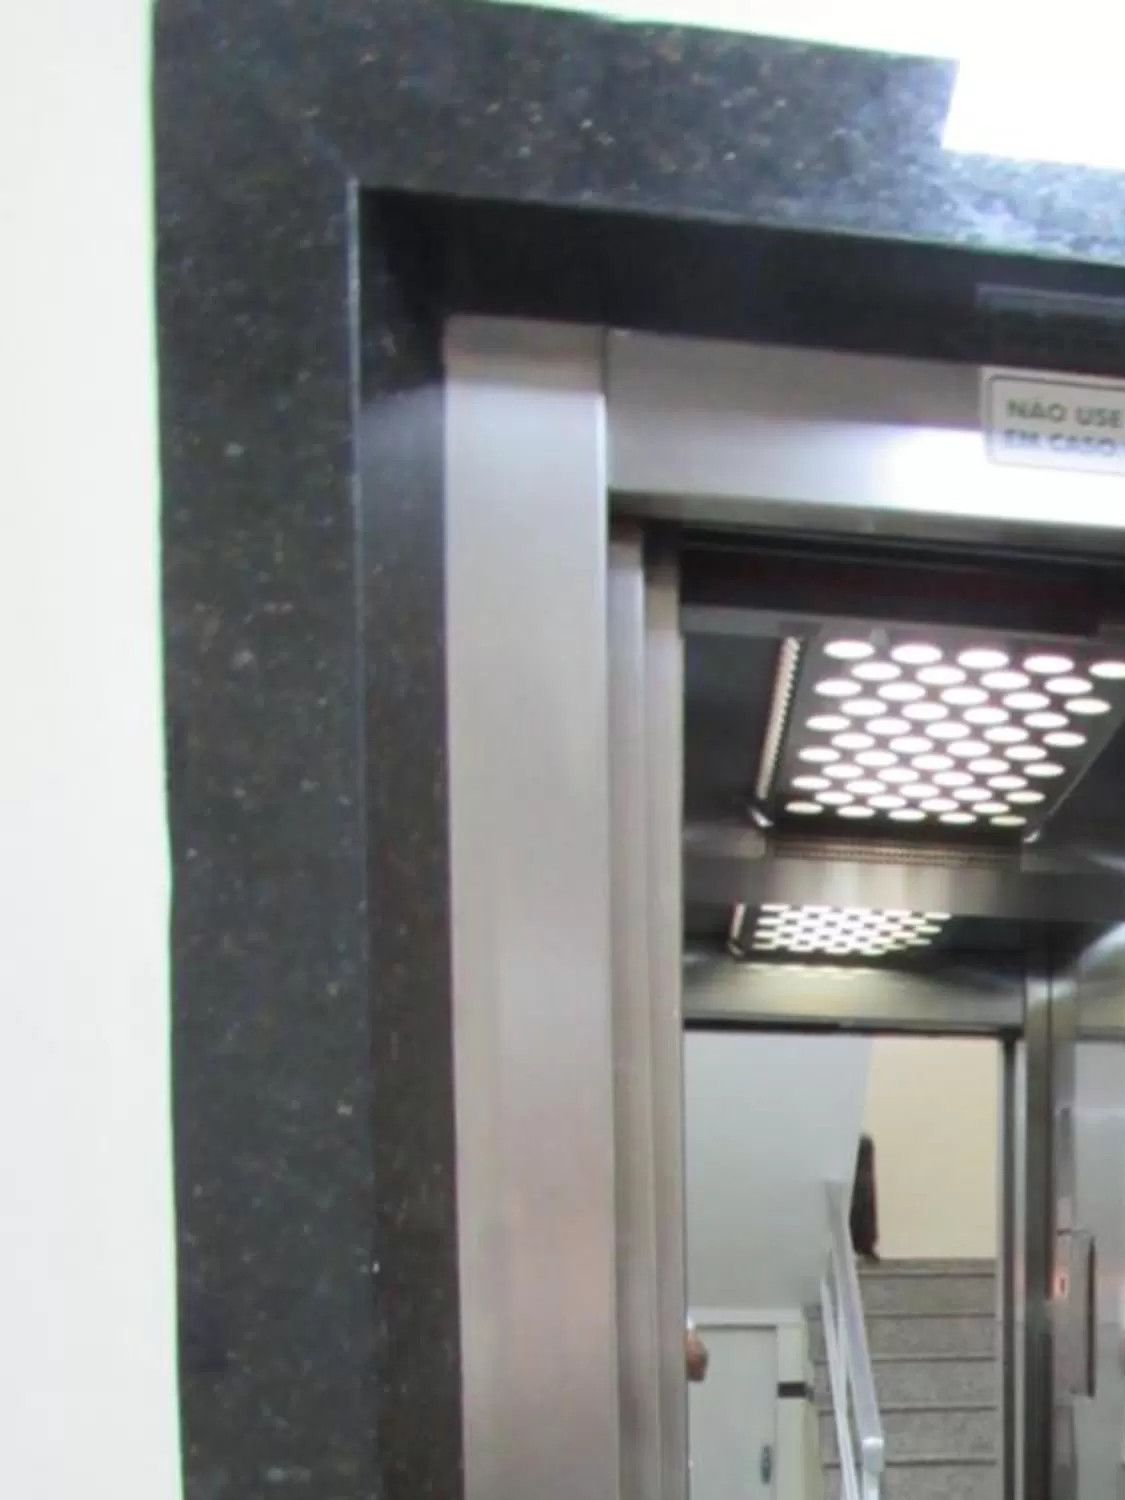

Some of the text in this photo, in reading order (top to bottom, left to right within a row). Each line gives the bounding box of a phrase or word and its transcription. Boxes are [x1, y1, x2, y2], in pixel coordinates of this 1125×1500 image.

[1006, 398, 1066, 423] NÃO
[1075, 406, 1122, 429] USE
[1004, 428, 1039, 449] EM
[1049, 432, 1116, 458] CASO
